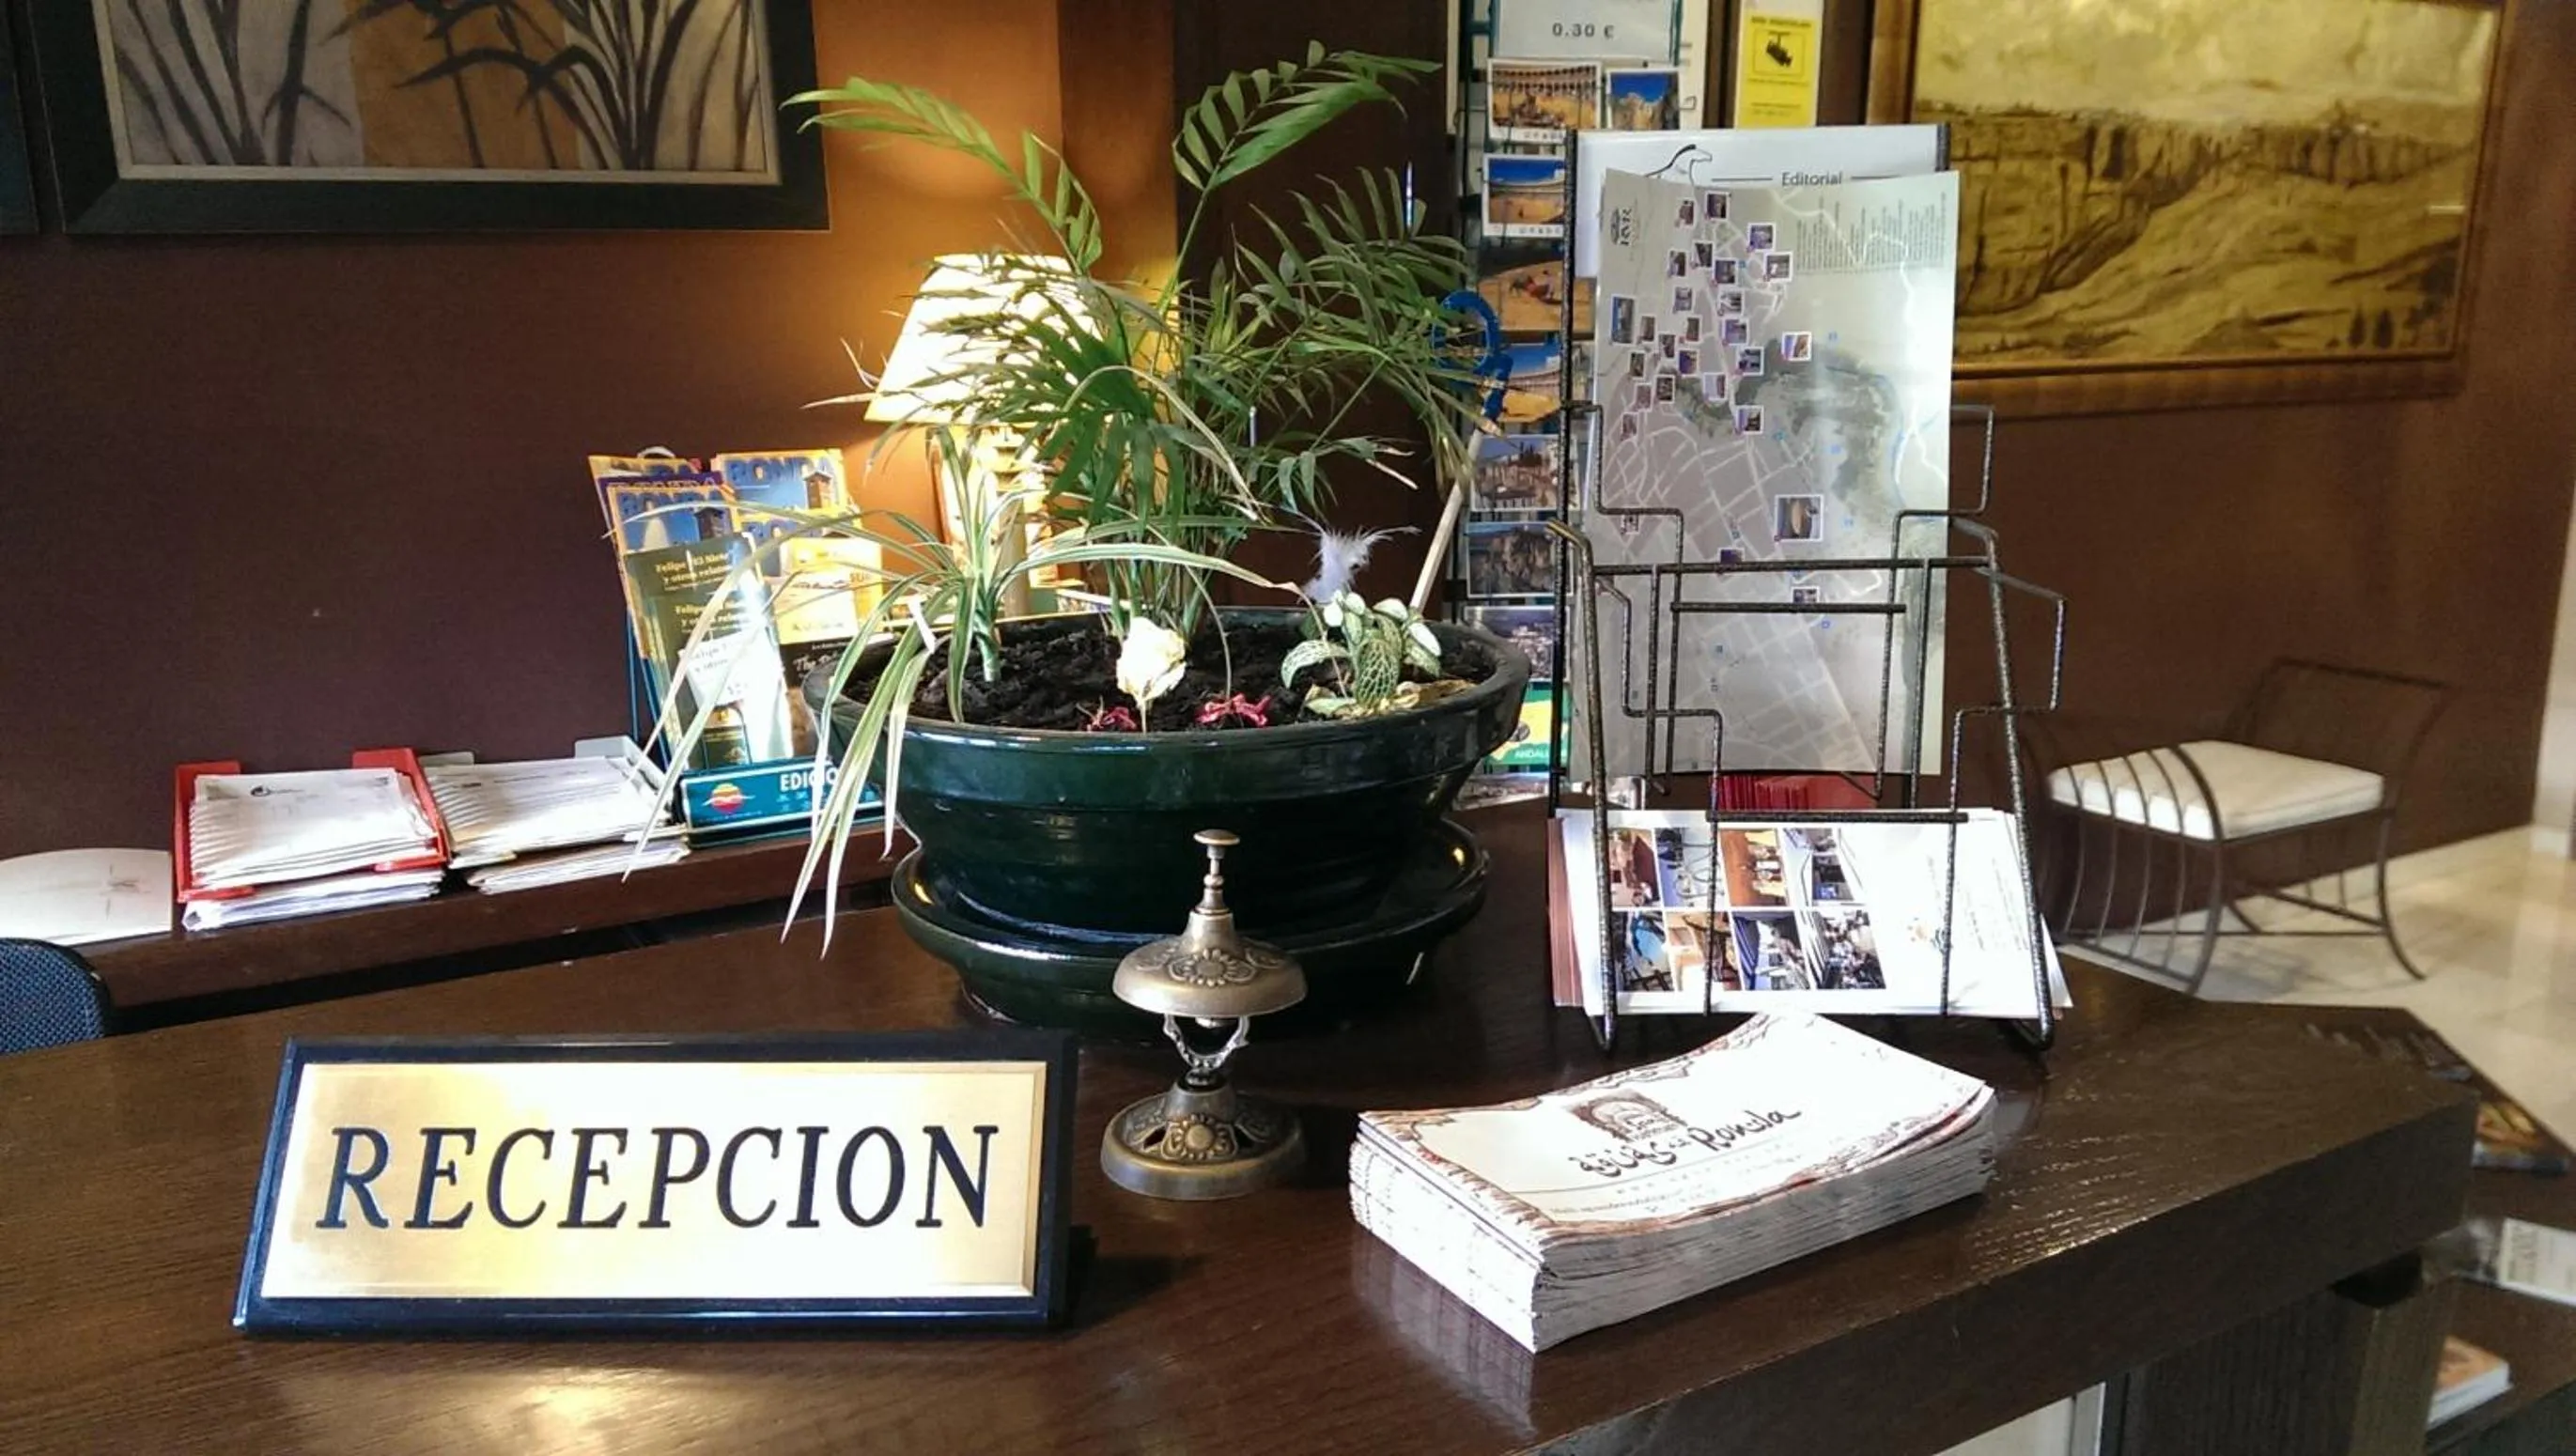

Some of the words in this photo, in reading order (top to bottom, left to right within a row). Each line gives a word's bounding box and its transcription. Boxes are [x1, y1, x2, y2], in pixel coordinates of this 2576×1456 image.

[1552, 23, 1595, 37] 0.30
[1781, 171, 1842, 187] Editorial
[316, 1125, 1000, 1231] RECEPCION
